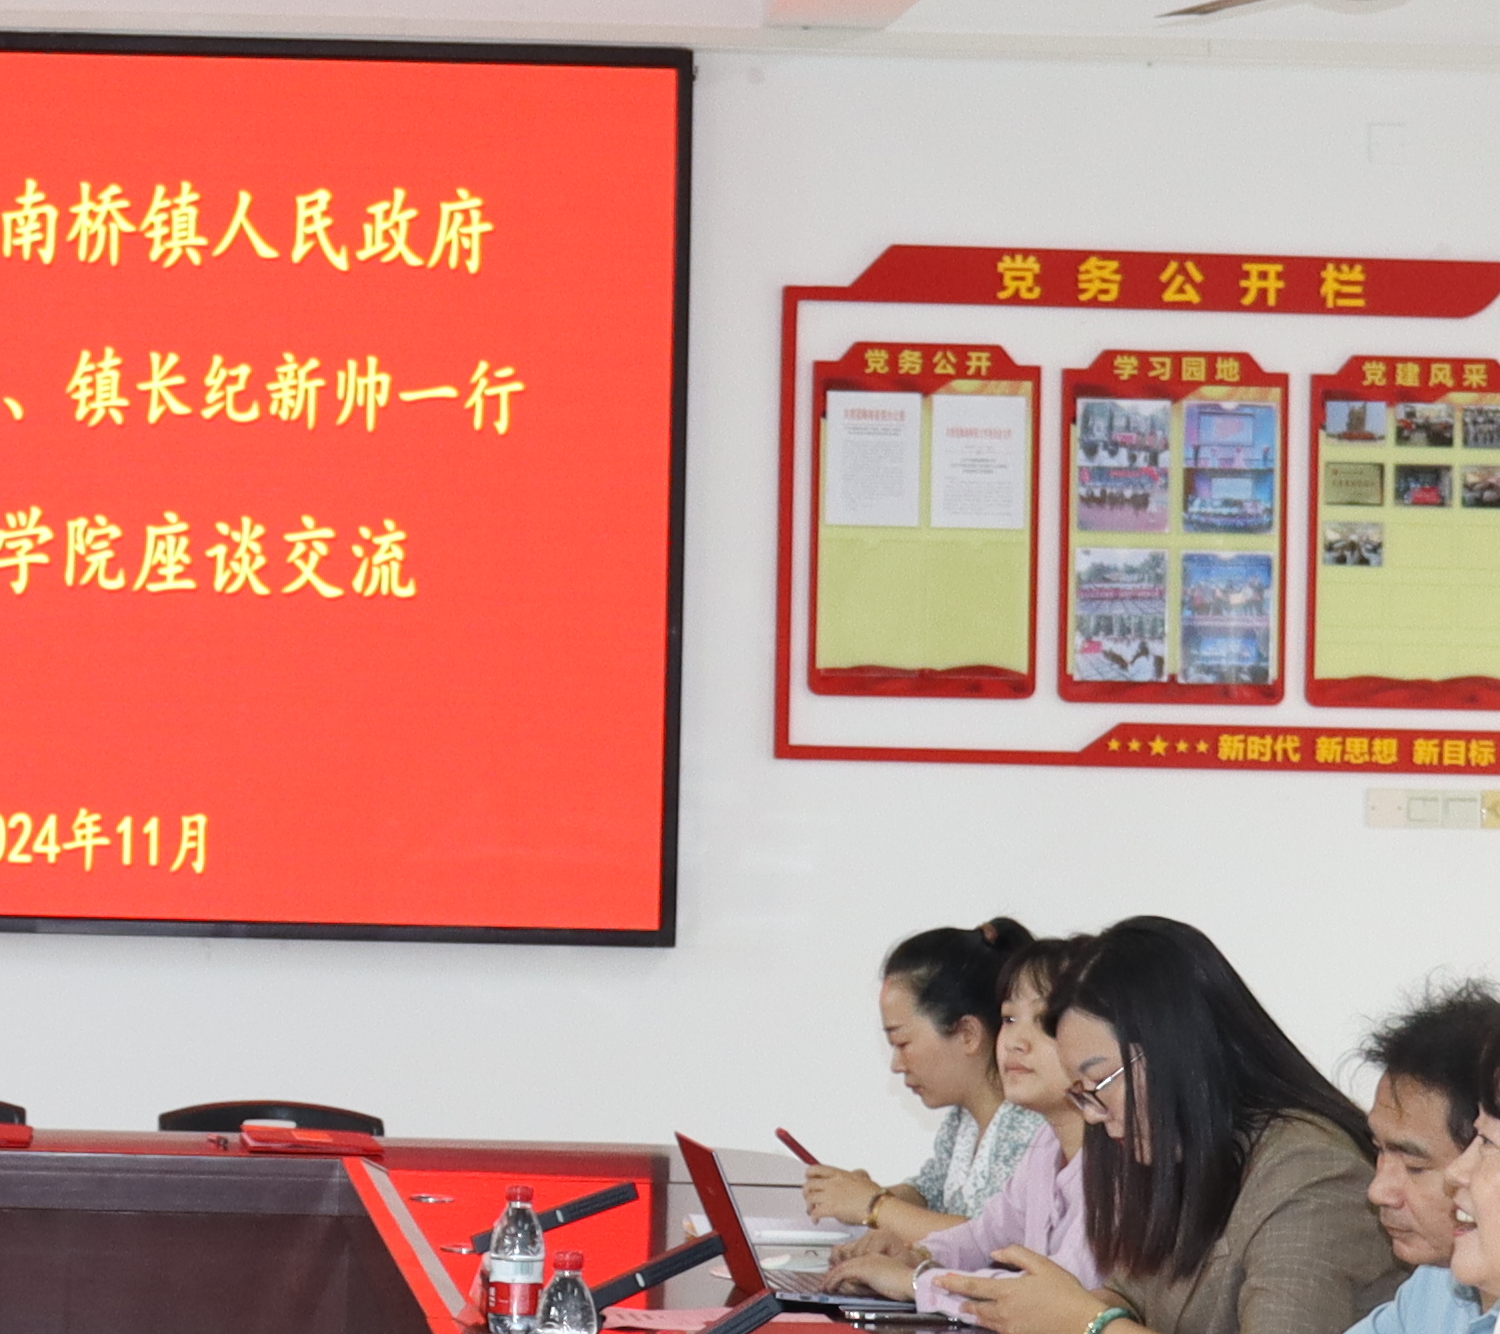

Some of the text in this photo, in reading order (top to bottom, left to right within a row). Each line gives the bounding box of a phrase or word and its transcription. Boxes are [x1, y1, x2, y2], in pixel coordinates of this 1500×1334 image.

[996, 254, 1367, 309] 党务公开栏
[864, 349, 992, 376] 党务公开
[1113, 355, 1241, 382] 学习园地
[1361, 360, 1488, 388] 党建风采
[1217, 733, 1301, 763] 新时代
[1315, 735, 1399, 765] 新思想
[1412, 737, 1496, 767] 新目标
